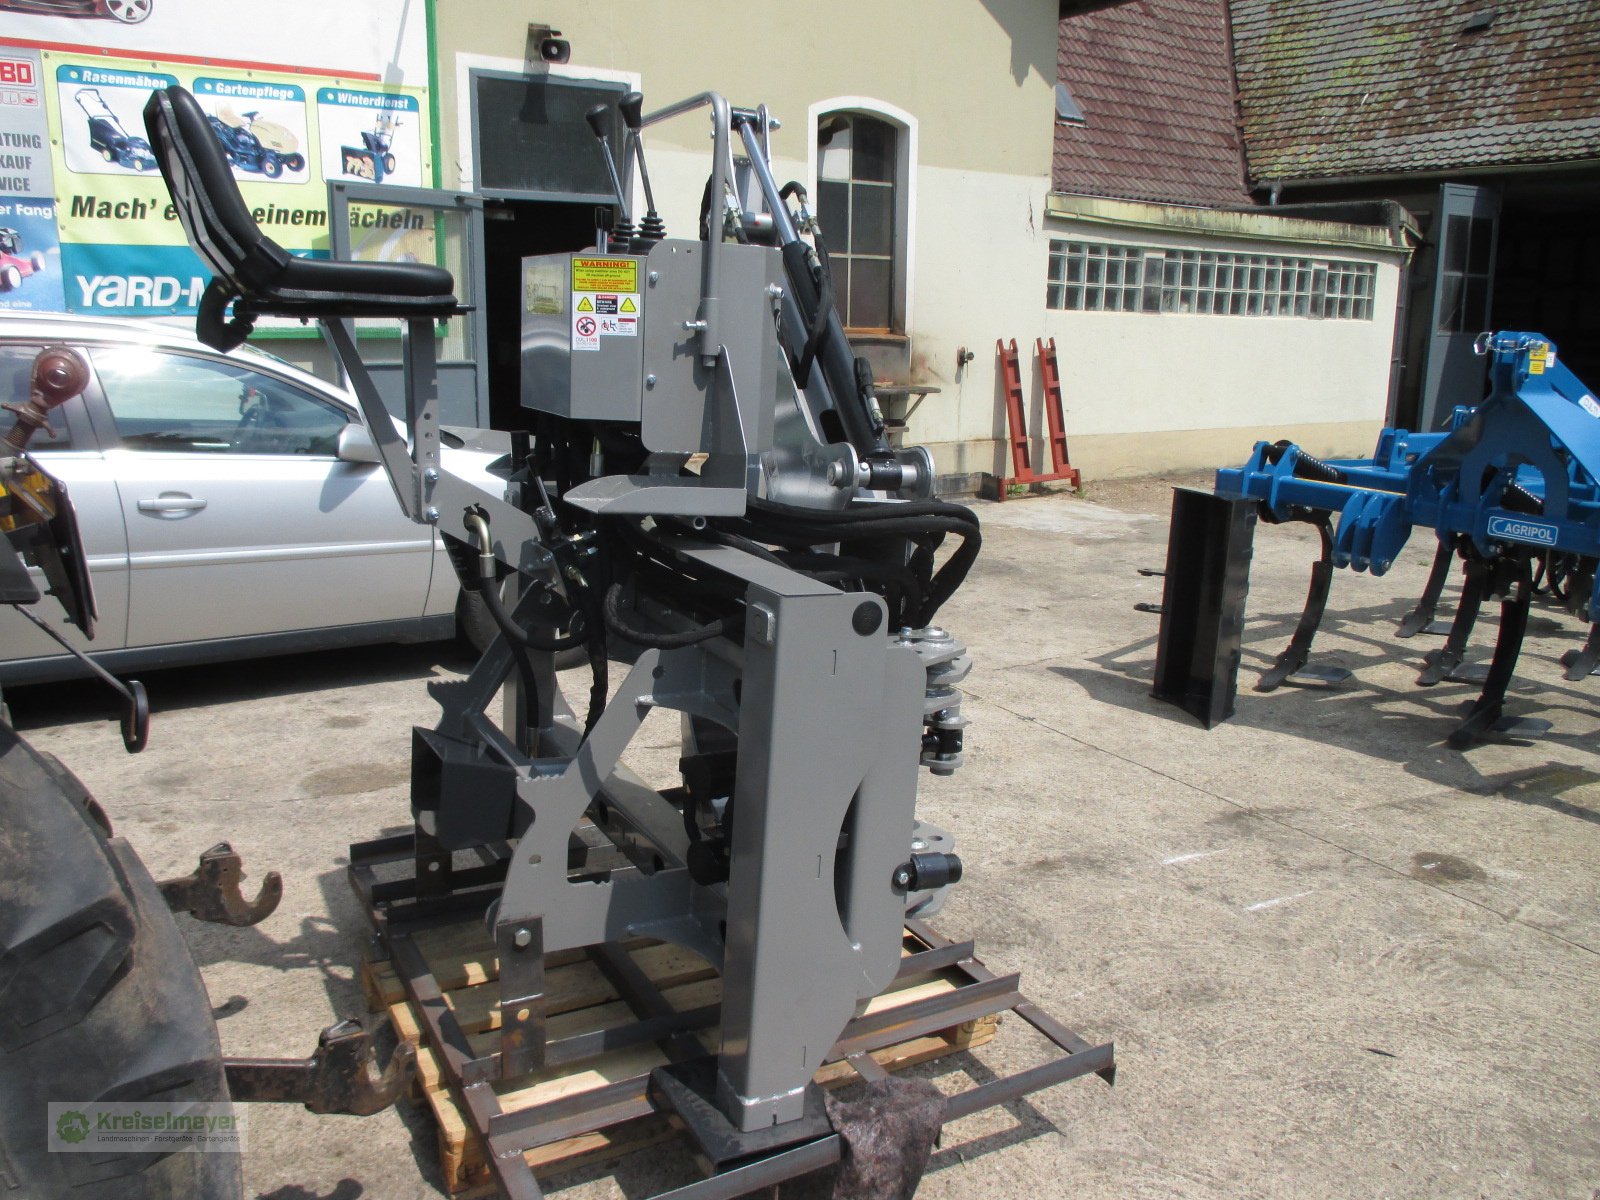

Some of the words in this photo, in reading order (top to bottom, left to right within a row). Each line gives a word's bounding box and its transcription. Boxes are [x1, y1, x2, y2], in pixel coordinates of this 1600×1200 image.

[82, 70, 167, 89] Rasenmähen
[216, 82, 294, 100] Gartenpflege
[337, 92, 409, 109] Winterdienst
[252, 204, 327, 226] einem
[1504, 523, 1553, 541] AGRIPOL
